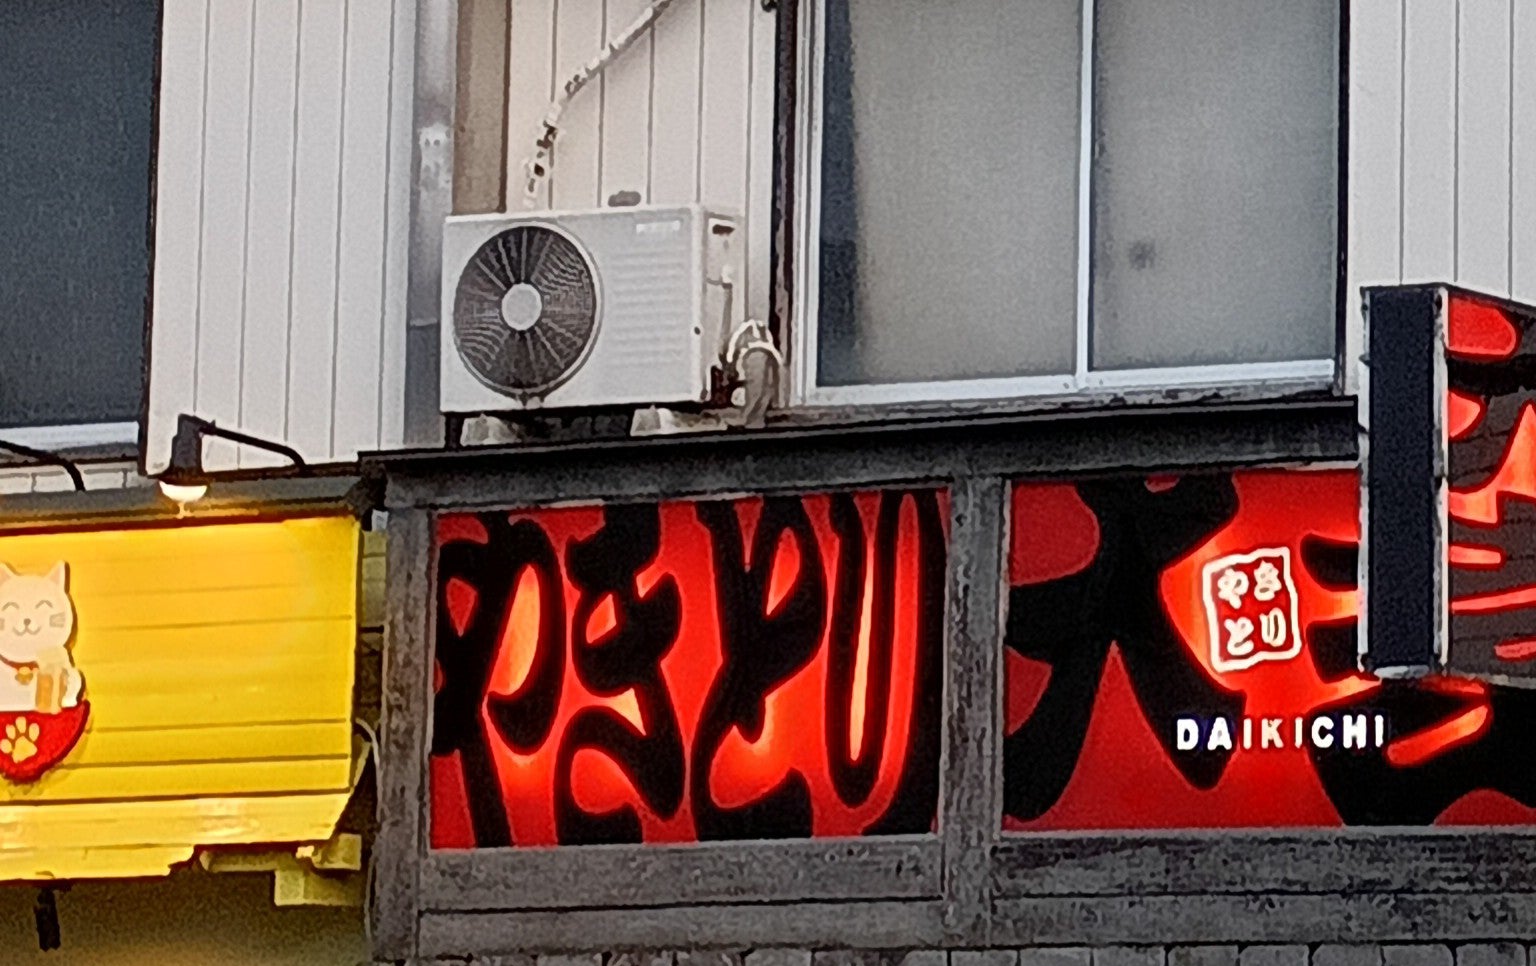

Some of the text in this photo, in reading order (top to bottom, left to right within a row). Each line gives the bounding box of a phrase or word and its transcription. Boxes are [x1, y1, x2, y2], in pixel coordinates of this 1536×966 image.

[433, 490, 945, 848] やきとり
[1176, 714, 1385, 751] DAIKICHI
